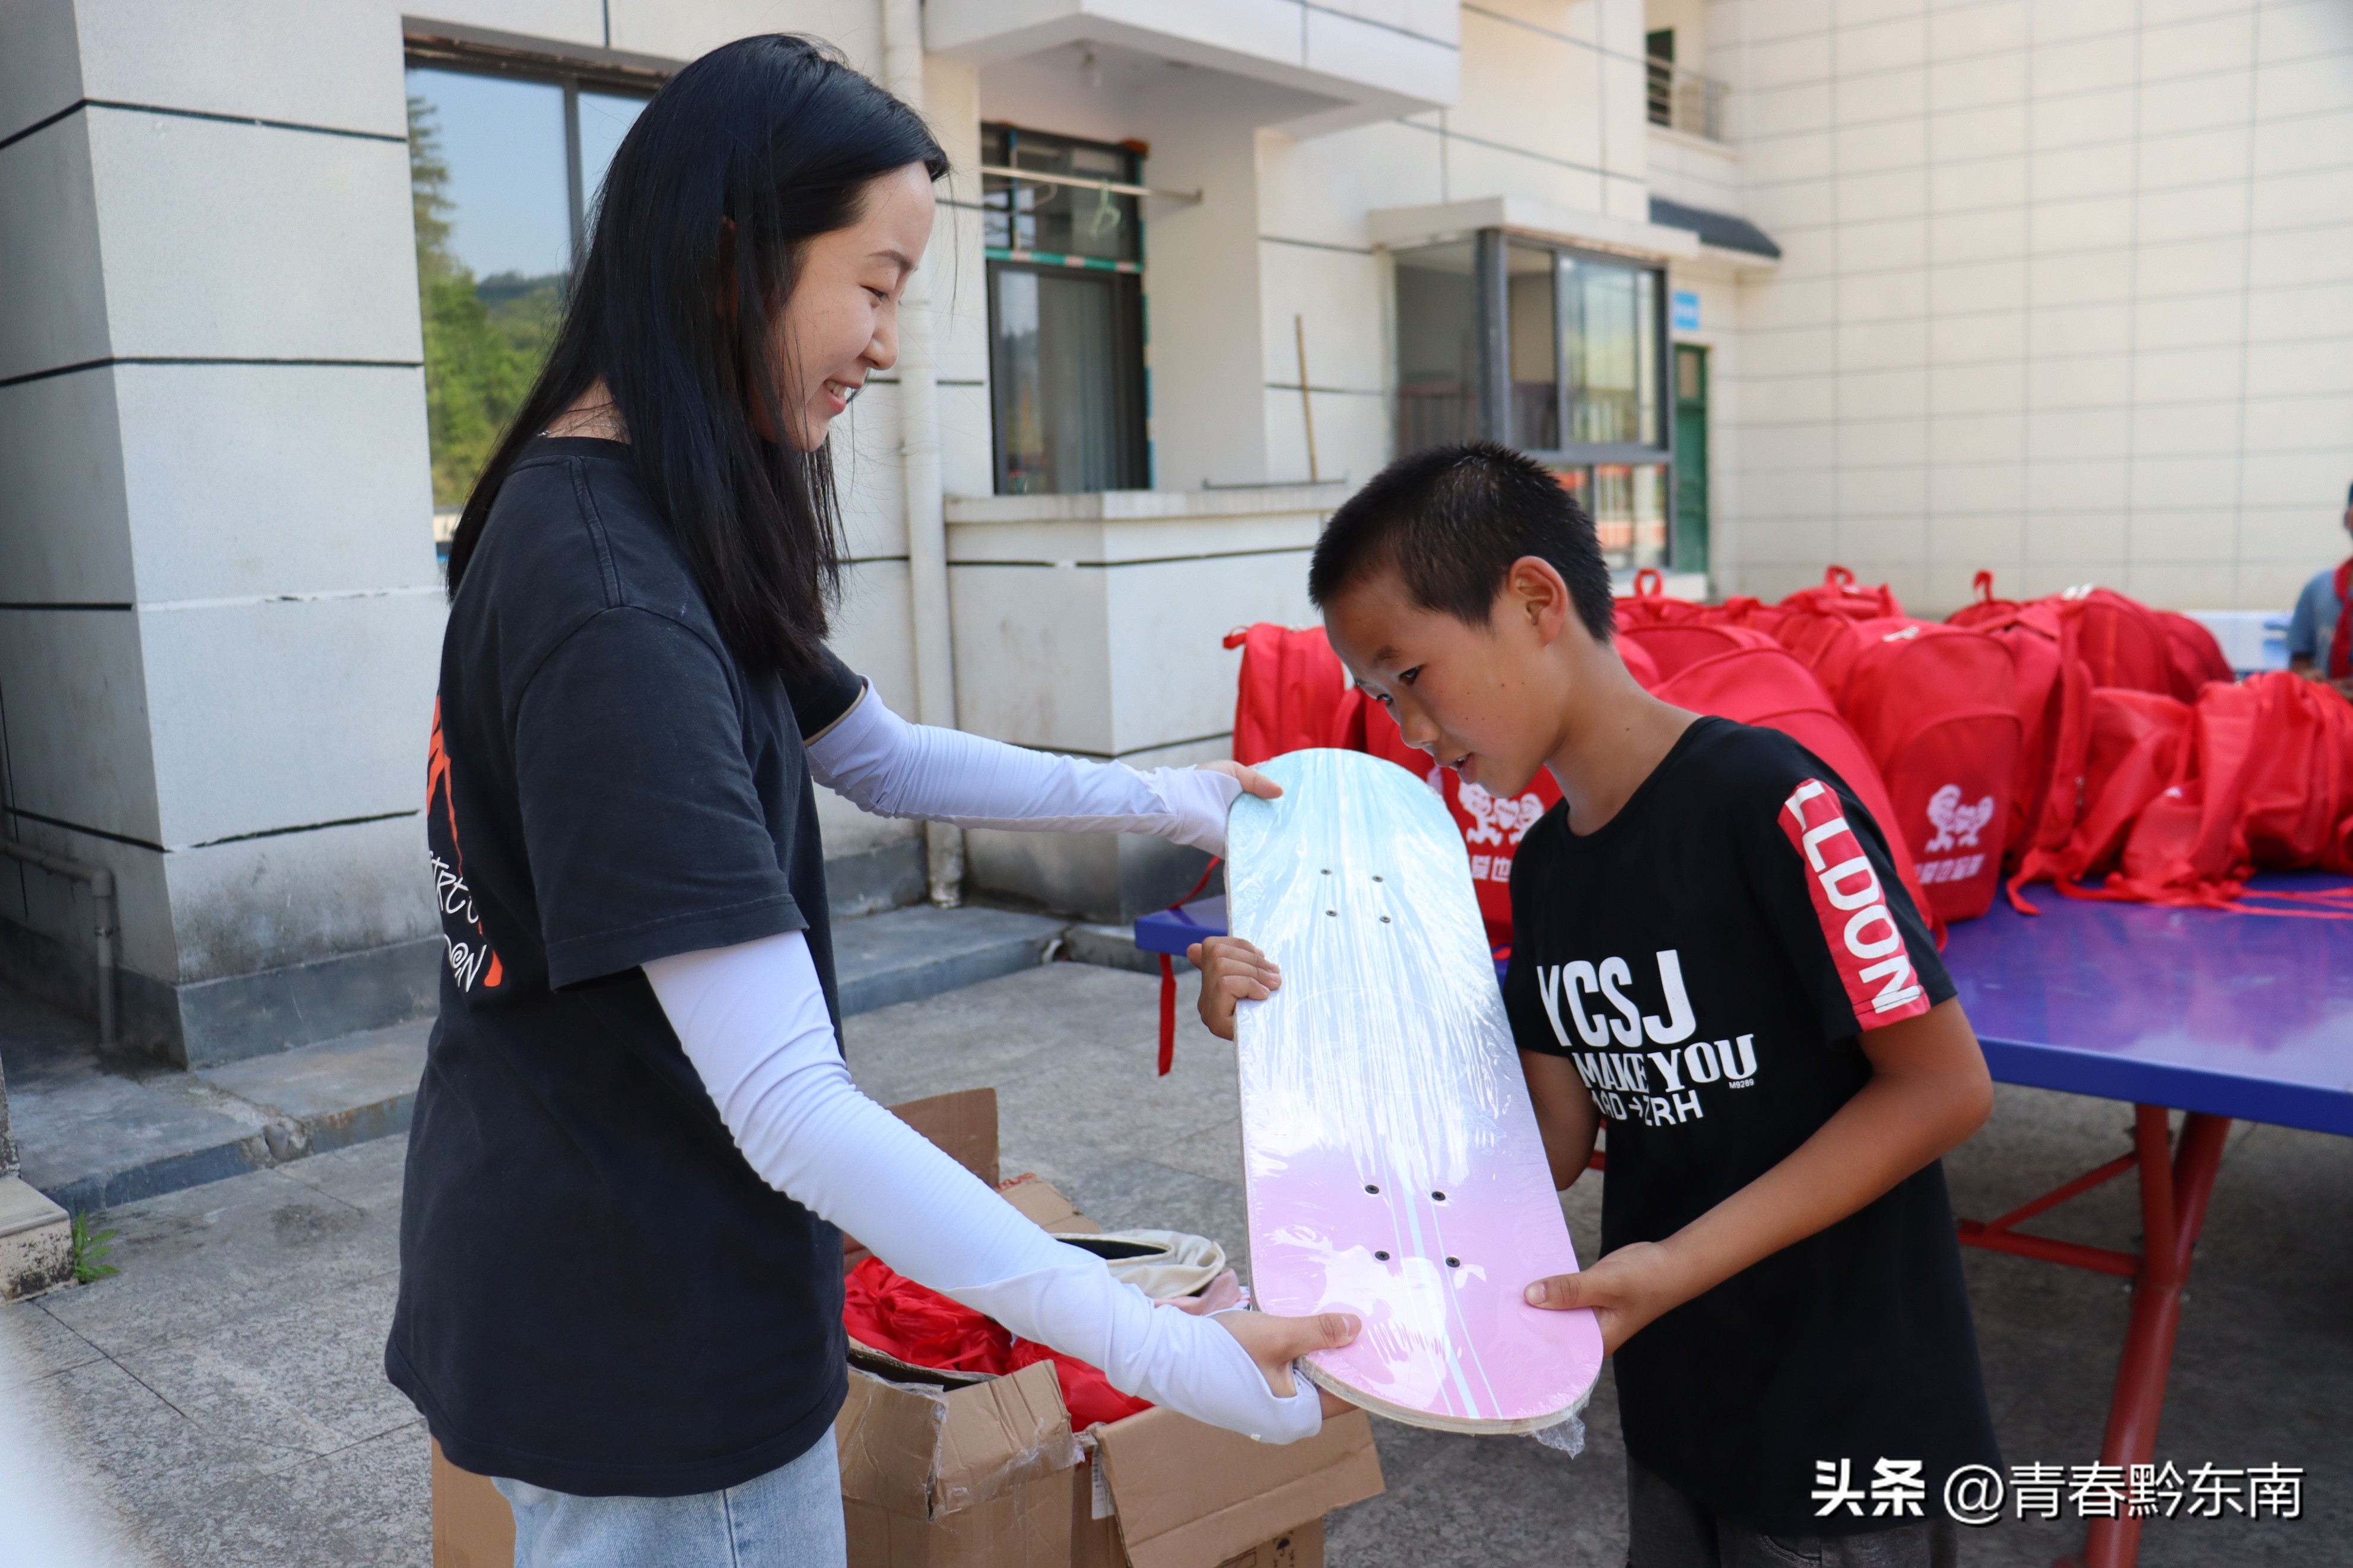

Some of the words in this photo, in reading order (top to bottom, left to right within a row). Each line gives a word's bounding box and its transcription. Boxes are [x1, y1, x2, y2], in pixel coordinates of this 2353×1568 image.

[1536, 949, 1696, 1048] YCSJ
[1571, 1052, 1650, 1094] MAKE
[1647, 1033, 1757, 1093] YOU
[1729, 1078, 1754, 1089] M9289
